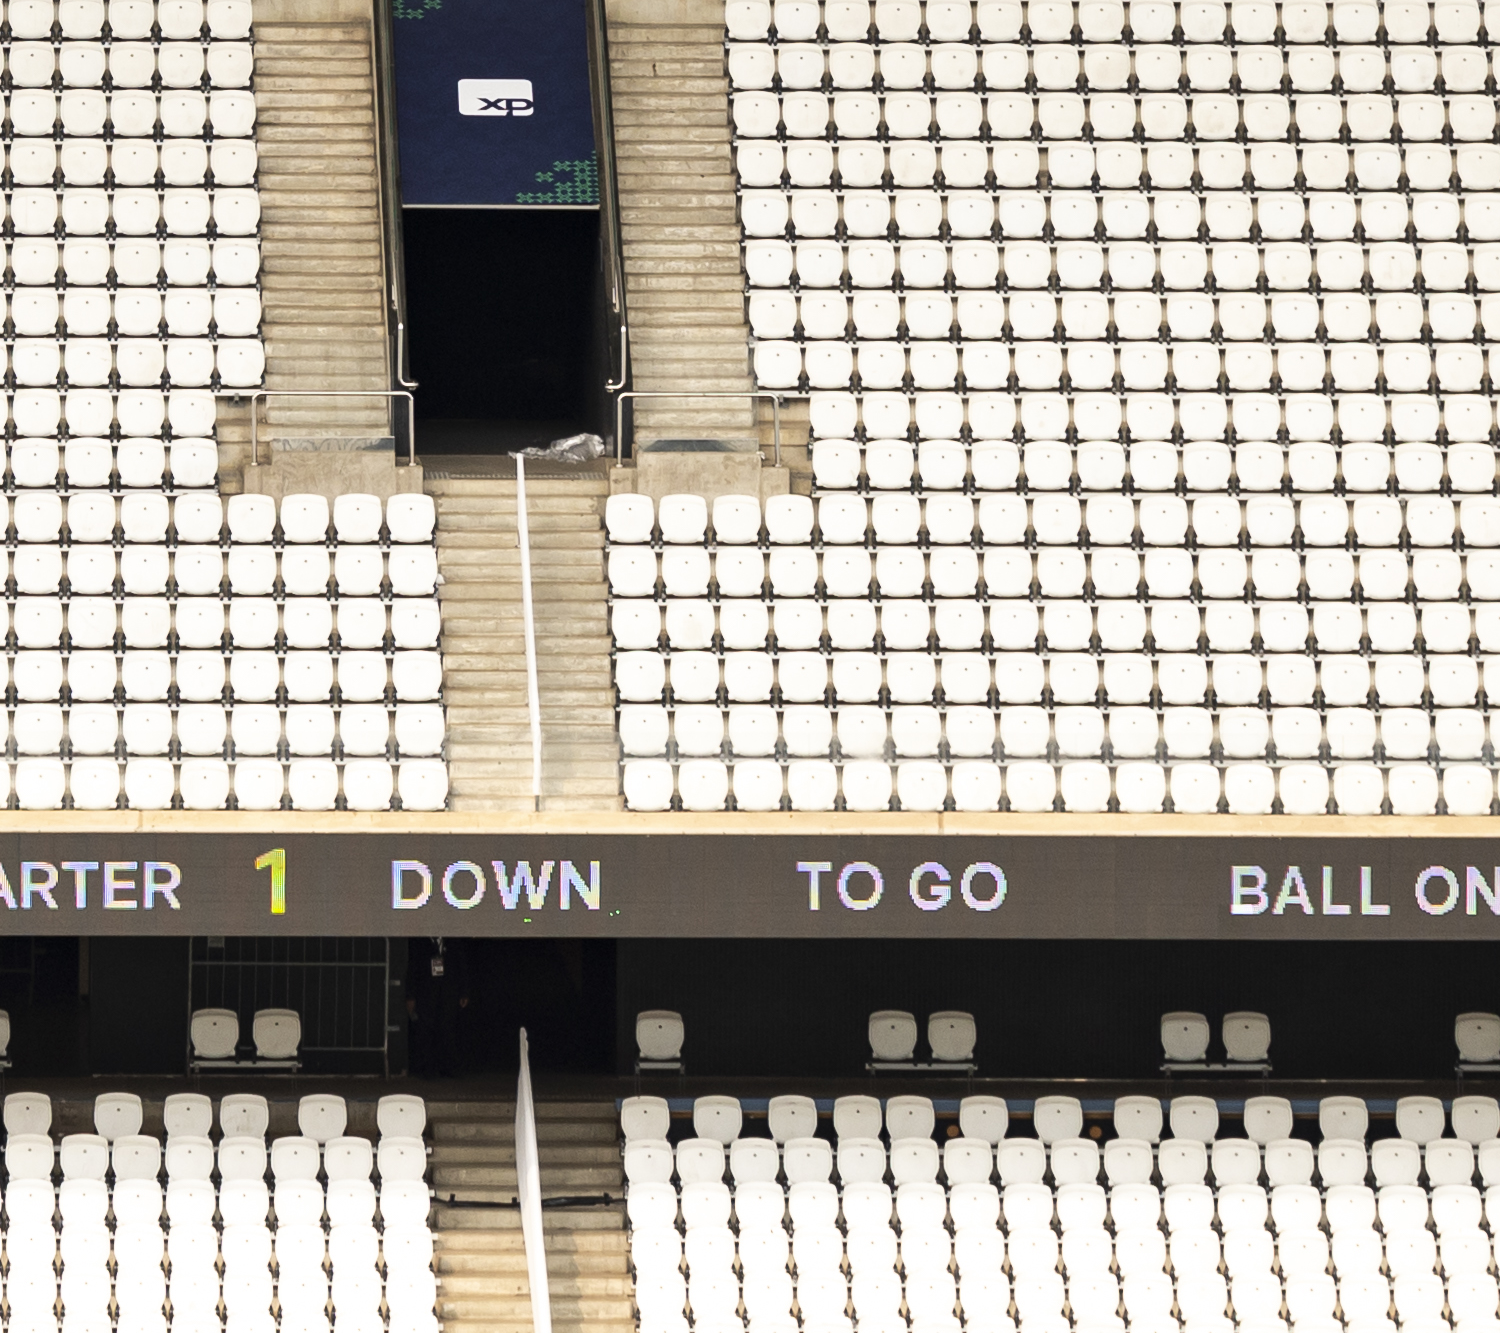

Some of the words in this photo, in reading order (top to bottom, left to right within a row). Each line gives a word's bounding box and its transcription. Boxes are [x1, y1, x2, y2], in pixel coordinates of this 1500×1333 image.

[254, 848, 287, 915] 1
[391, 859, 602, 911] DOWN
[796, 860, 885, 911] TO
[908, 860, 1009, 912] GO
[1229, 864, 1392, 916] BALL
